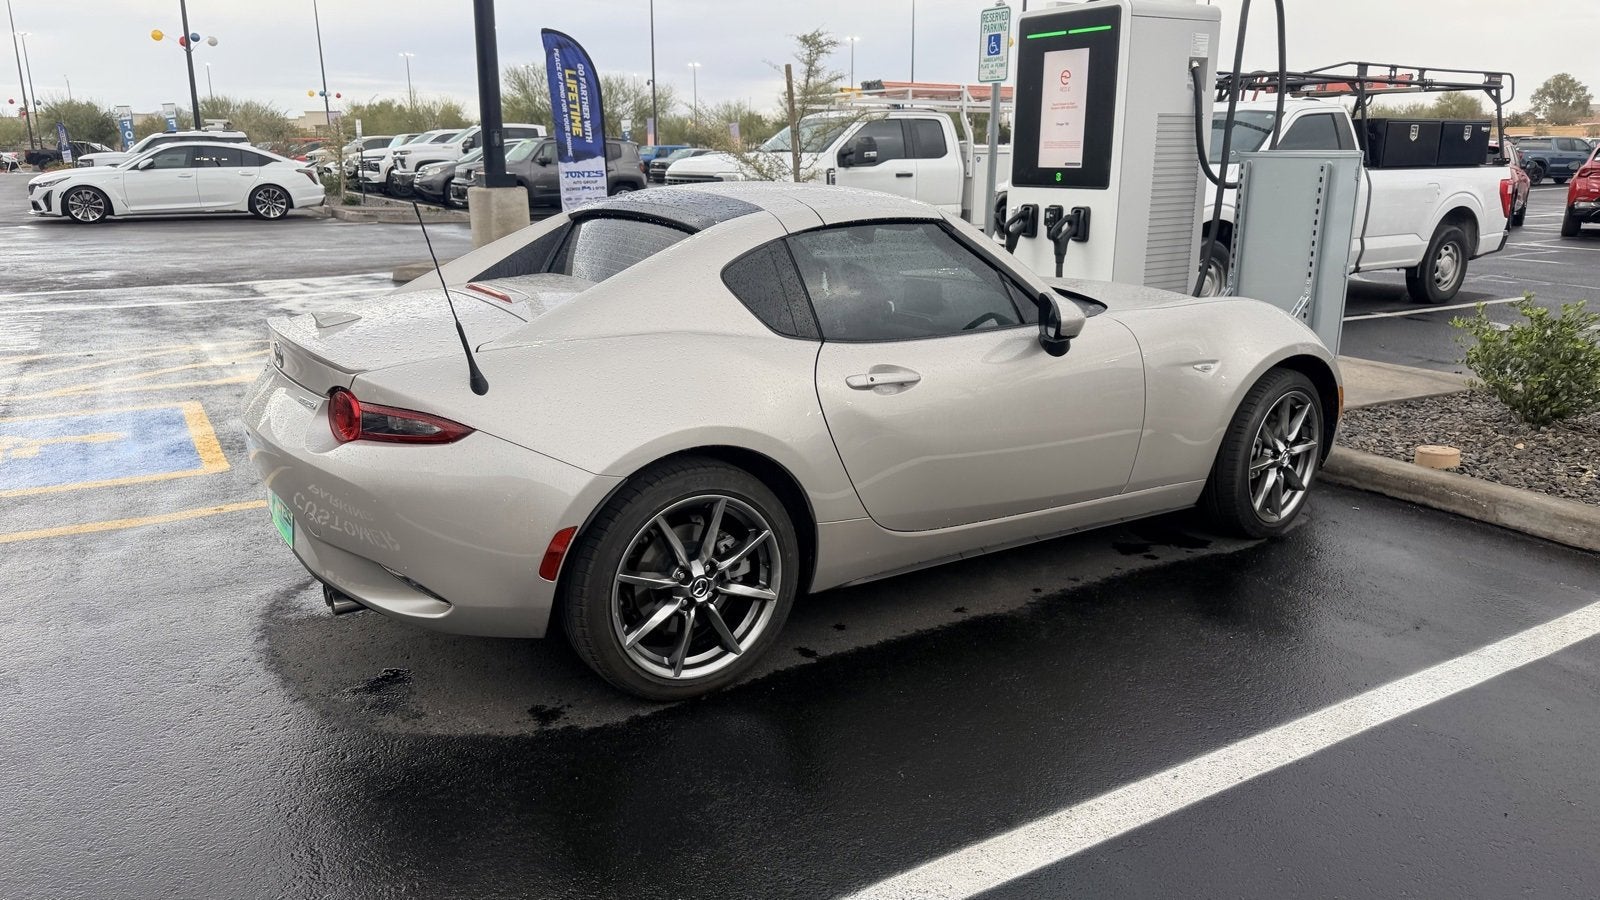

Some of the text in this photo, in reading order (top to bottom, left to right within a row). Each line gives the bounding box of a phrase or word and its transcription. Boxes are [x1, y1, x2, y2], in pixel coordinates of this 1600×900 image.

[983, 10, 1008, 22] RESERVED
[983, 22, 1007, 33] PARKING
[553, 48, 562, 71] PEACE
[557, 72, 563, 81] OF
[564, 69, 582, 137] LIFETIME
[577, 63, 593, 143] GO FARTHER WITH
[565, 132, 573, 157] ENGINE
[565, 170, 604, 178] JONES
